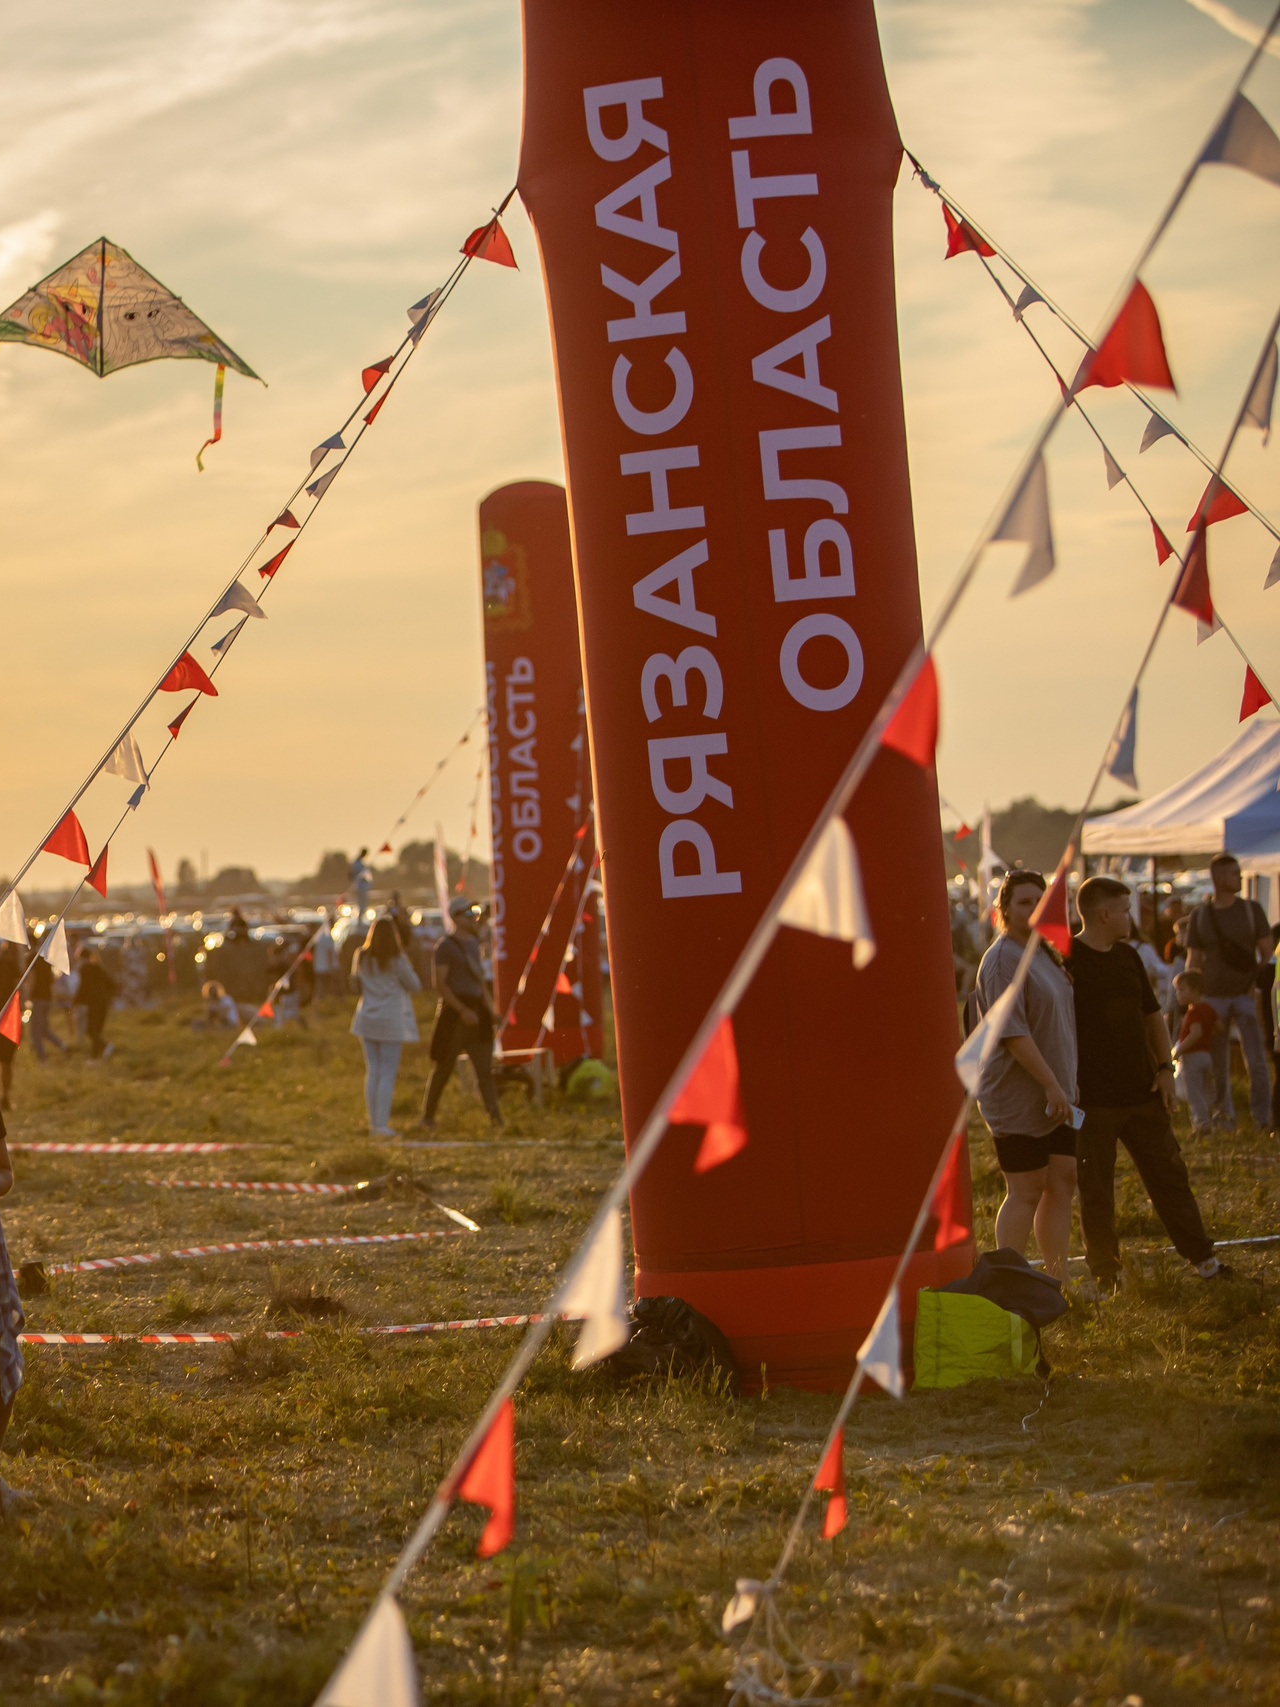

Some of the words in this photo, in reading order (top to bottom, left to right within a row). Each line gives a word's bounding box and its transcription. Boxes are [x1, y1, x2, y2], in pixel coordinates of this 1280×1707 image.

[583, 76, 742, 899] РЯЗАНСКАЯ
[728, 57, 864, 712] ОБЛАСТЬ
[506, 657, 542, 861] ОБЛАСТЬ
